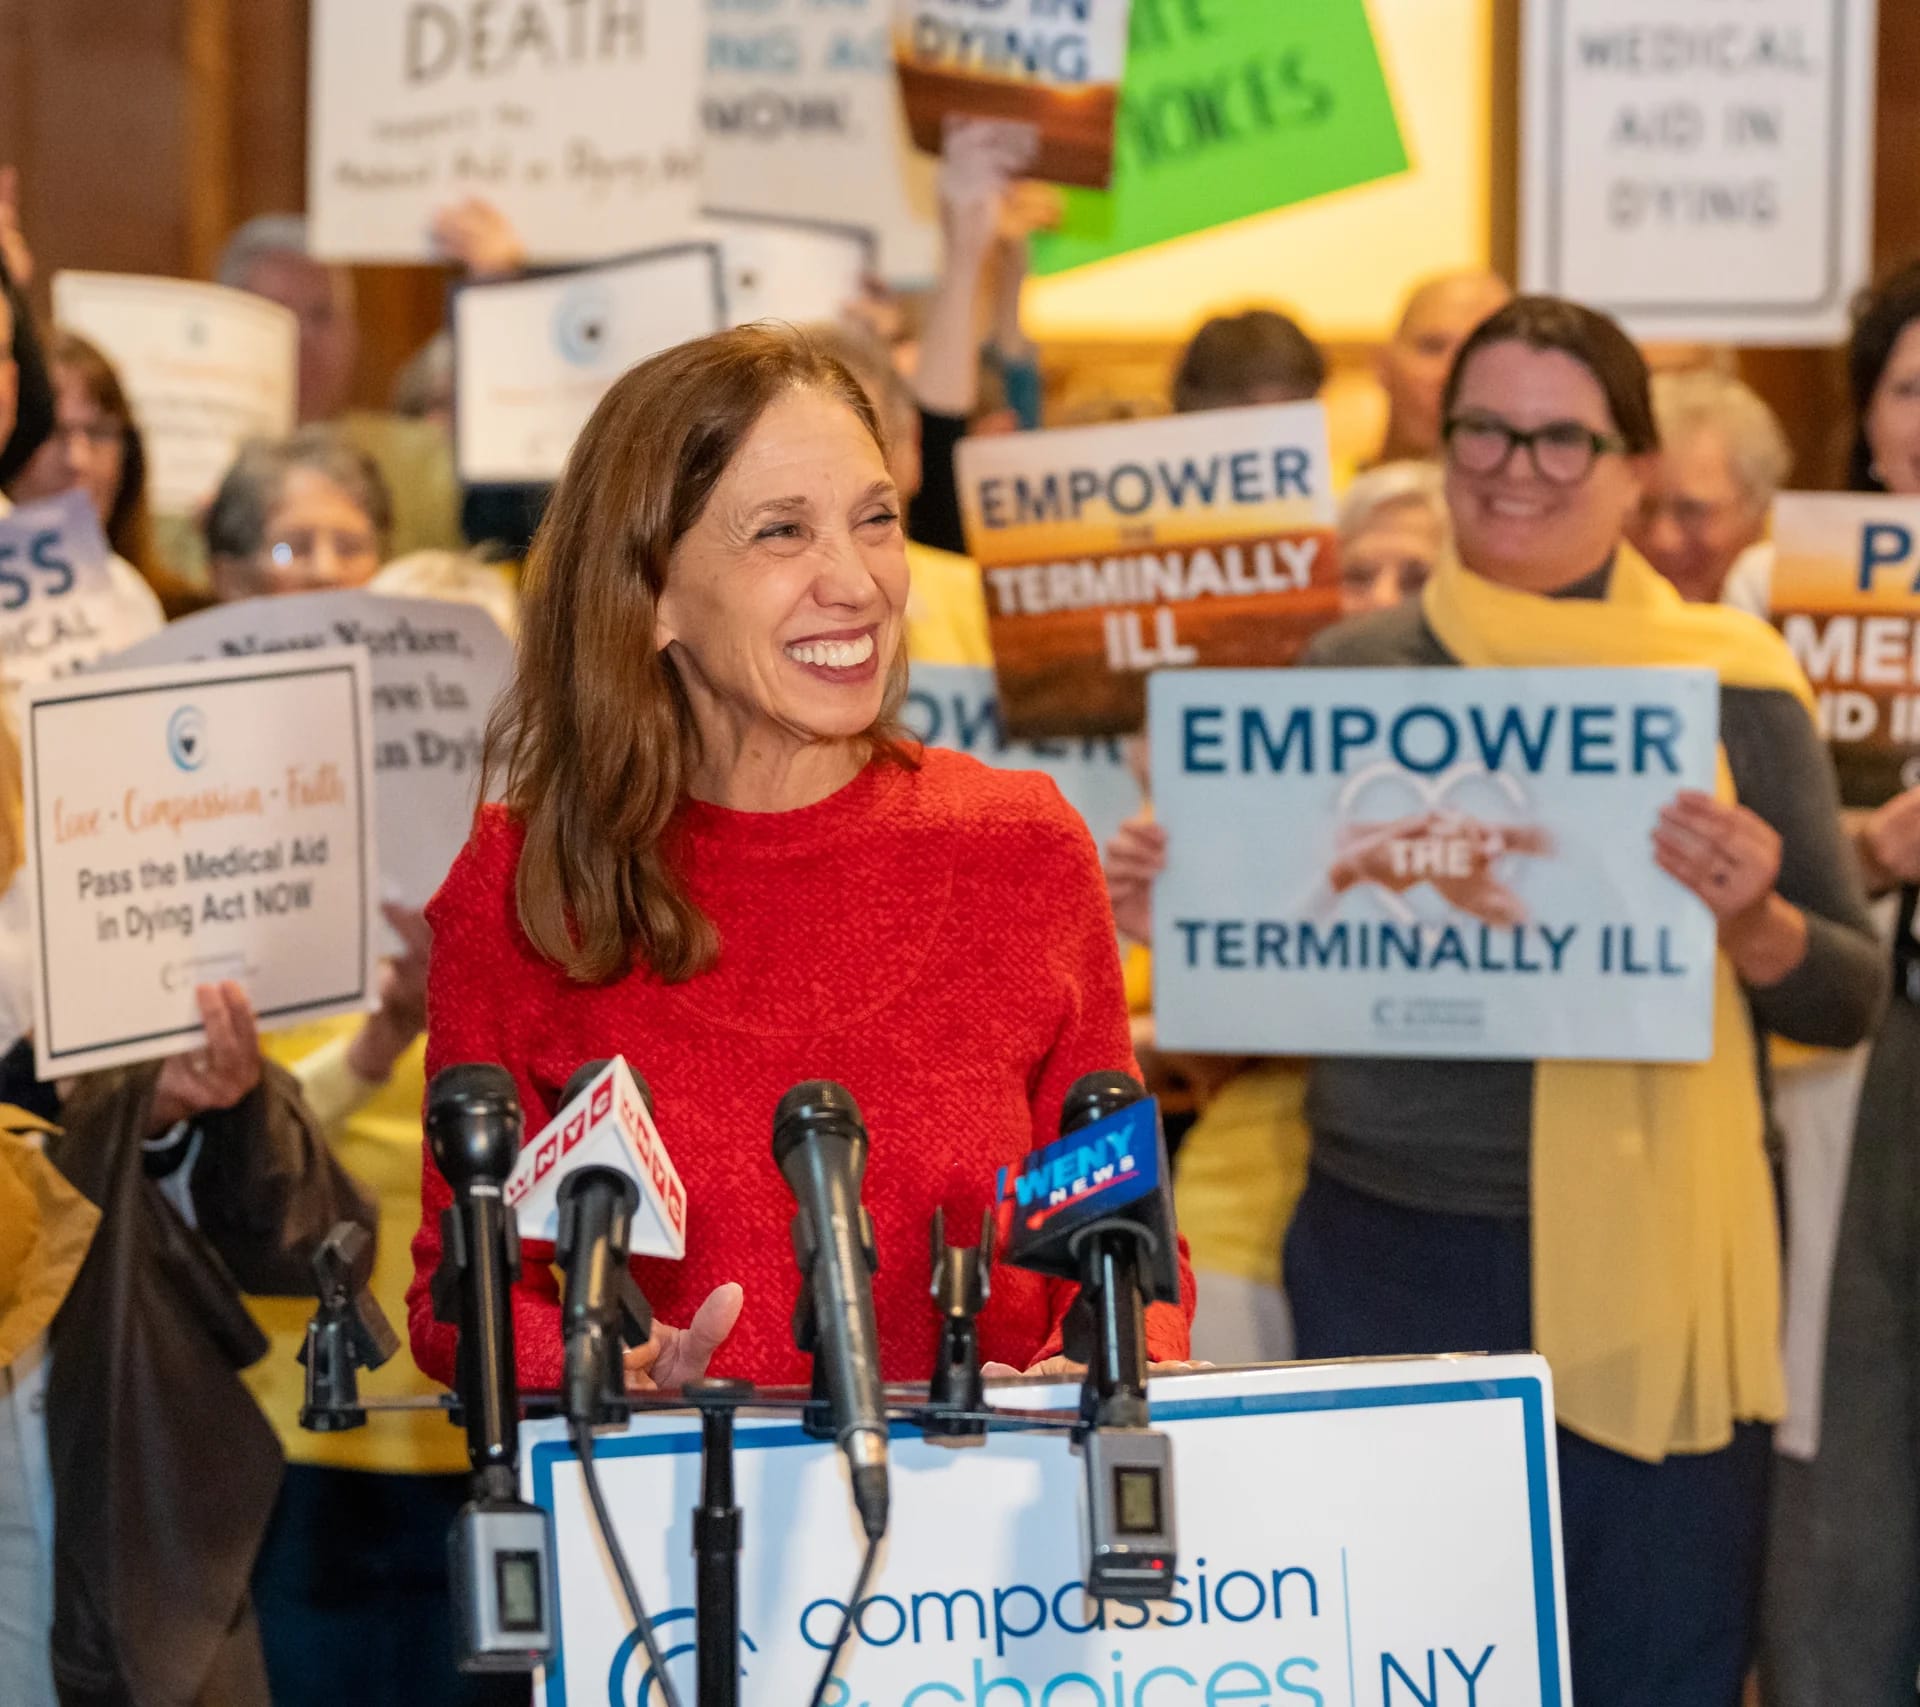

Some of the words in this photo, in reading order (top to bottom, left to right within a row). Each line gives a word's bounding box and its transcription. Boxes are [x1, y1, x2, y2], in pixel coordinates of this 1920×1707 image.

[403, 0, 646, 86] DEATH
[910, 14, 1090, 83] DYING
[1576, 25, 1813, 73] MEDICAL
[1608, 104, 1702, 151] AID
[1724, 107, 1780, 148] IN
[1608, 176, 1778, 231] DYING
[978, 445, 1313, 530] EMPOWER
[986, 537, 1320, 617] TERMINALLY
[1857, 520, 1920, 593] P
[1103, 605, 1199, 673] ILL
[1783, 613, 1920, 685] ME
[1181, 704, 1685, 775] EMPOWER
[1890, 692, 1920, 743] I
[54, 796, 99, 844] Love
[123, 786, 262, 837] Compassion
[286, 762, 345, 812] Faith
[78, 868, 133, 899] Pass
[140, 857, 177, 890] the
[184, 840, 284, 882] Medical
[291, 834, 329, 866] Aid
[1390, 839, 1472, 877] THE
[98, 909, 119, 941] in
[125, 902, 195, 942] Dying
[202, 891, 246, 924] Act
[254, 877, 315, 917] NOW
[1176, 919, 1577, 974] TERMINALLY
[1599, 925, 1688, 975] ILL
[508, 1074, 615, 1207] WNYC
[621, 1096, 683, 1234] WNYC
[1015, 1120, 1136, 1206] WENY
[1050, 1154, 1136, 1205] NEWS
[1380, 1645, 1497, 1707] NY
